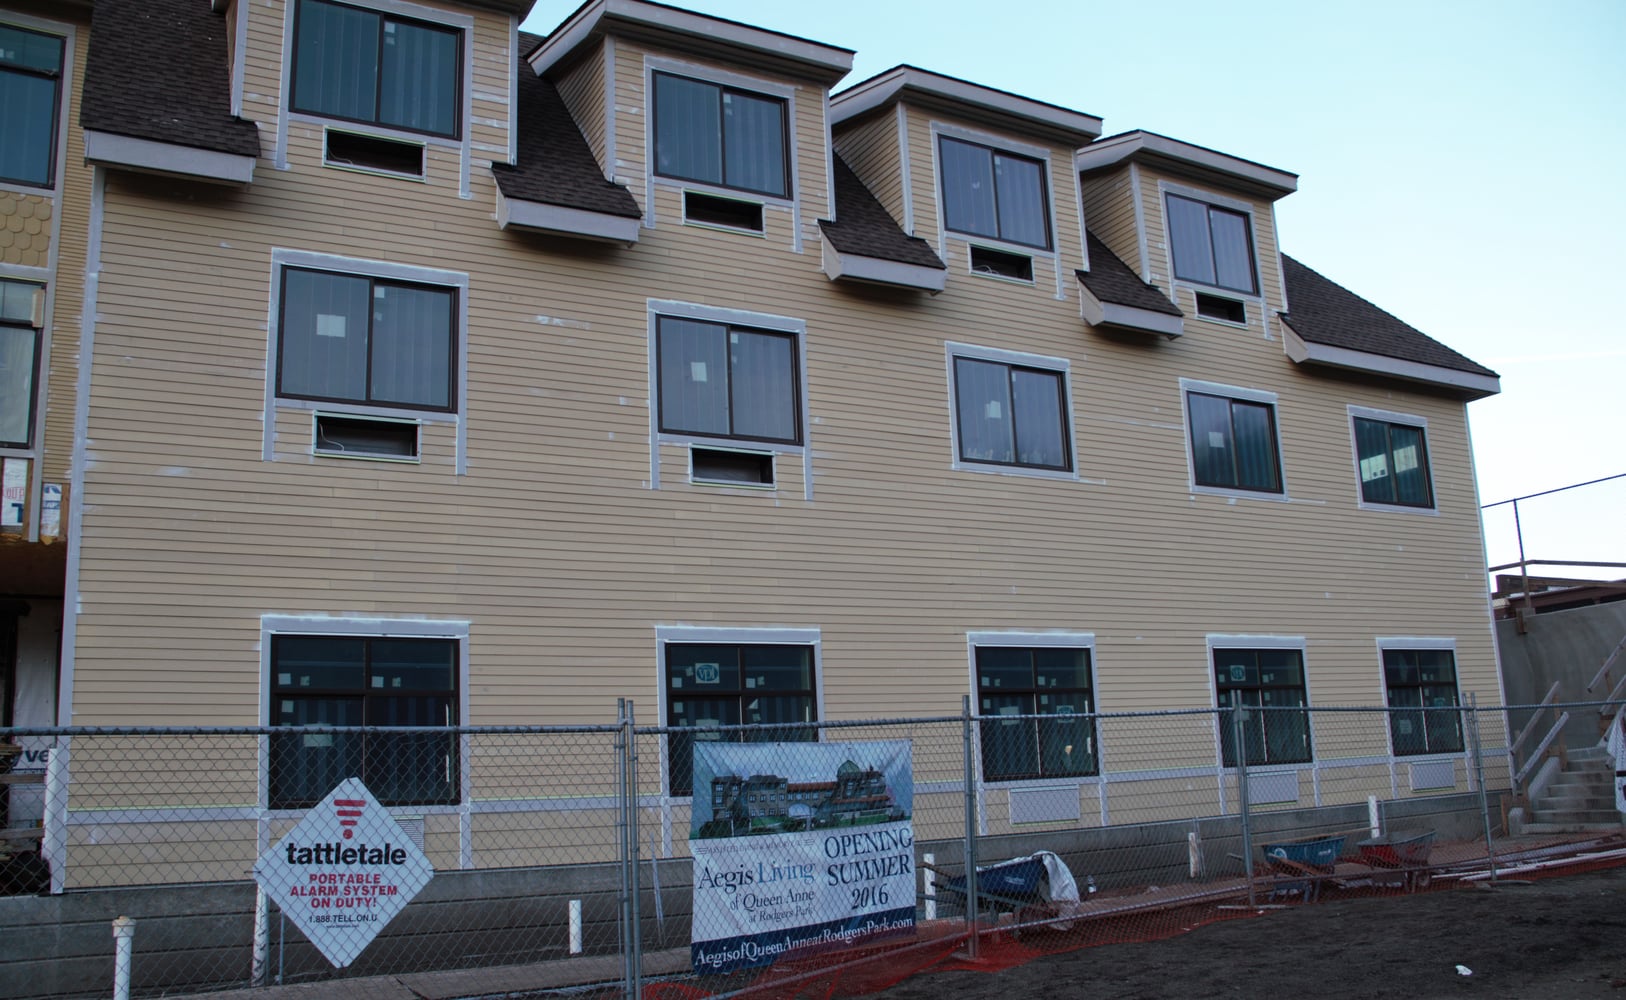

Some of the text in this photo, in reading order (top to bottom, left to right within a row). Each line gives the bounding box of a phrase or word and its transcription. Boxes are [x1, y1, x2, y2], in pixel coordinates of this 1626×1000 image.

[286, 842, 407, 865] tattletale
[824, 827, 913, 859] OPENING
[309, 873, 382, 884] PORTABLE
[698, 859, 815, 894] Aegis Living
[827, 854, 912, 886] SUMMER
[290, 885, 398, 896] ALARM SYSTEM
[311, 897, 377, 908] ON DUTY!
[730, 888, 815, 912] of Queen Anne
[851, 883, 889, 910] 2016
[760, 909, 794, 922] Rodgers
[795, 903, 814, 917] Park
[695, 917, 913, 968] AegisofQueenAnneatRodgersPark.com
